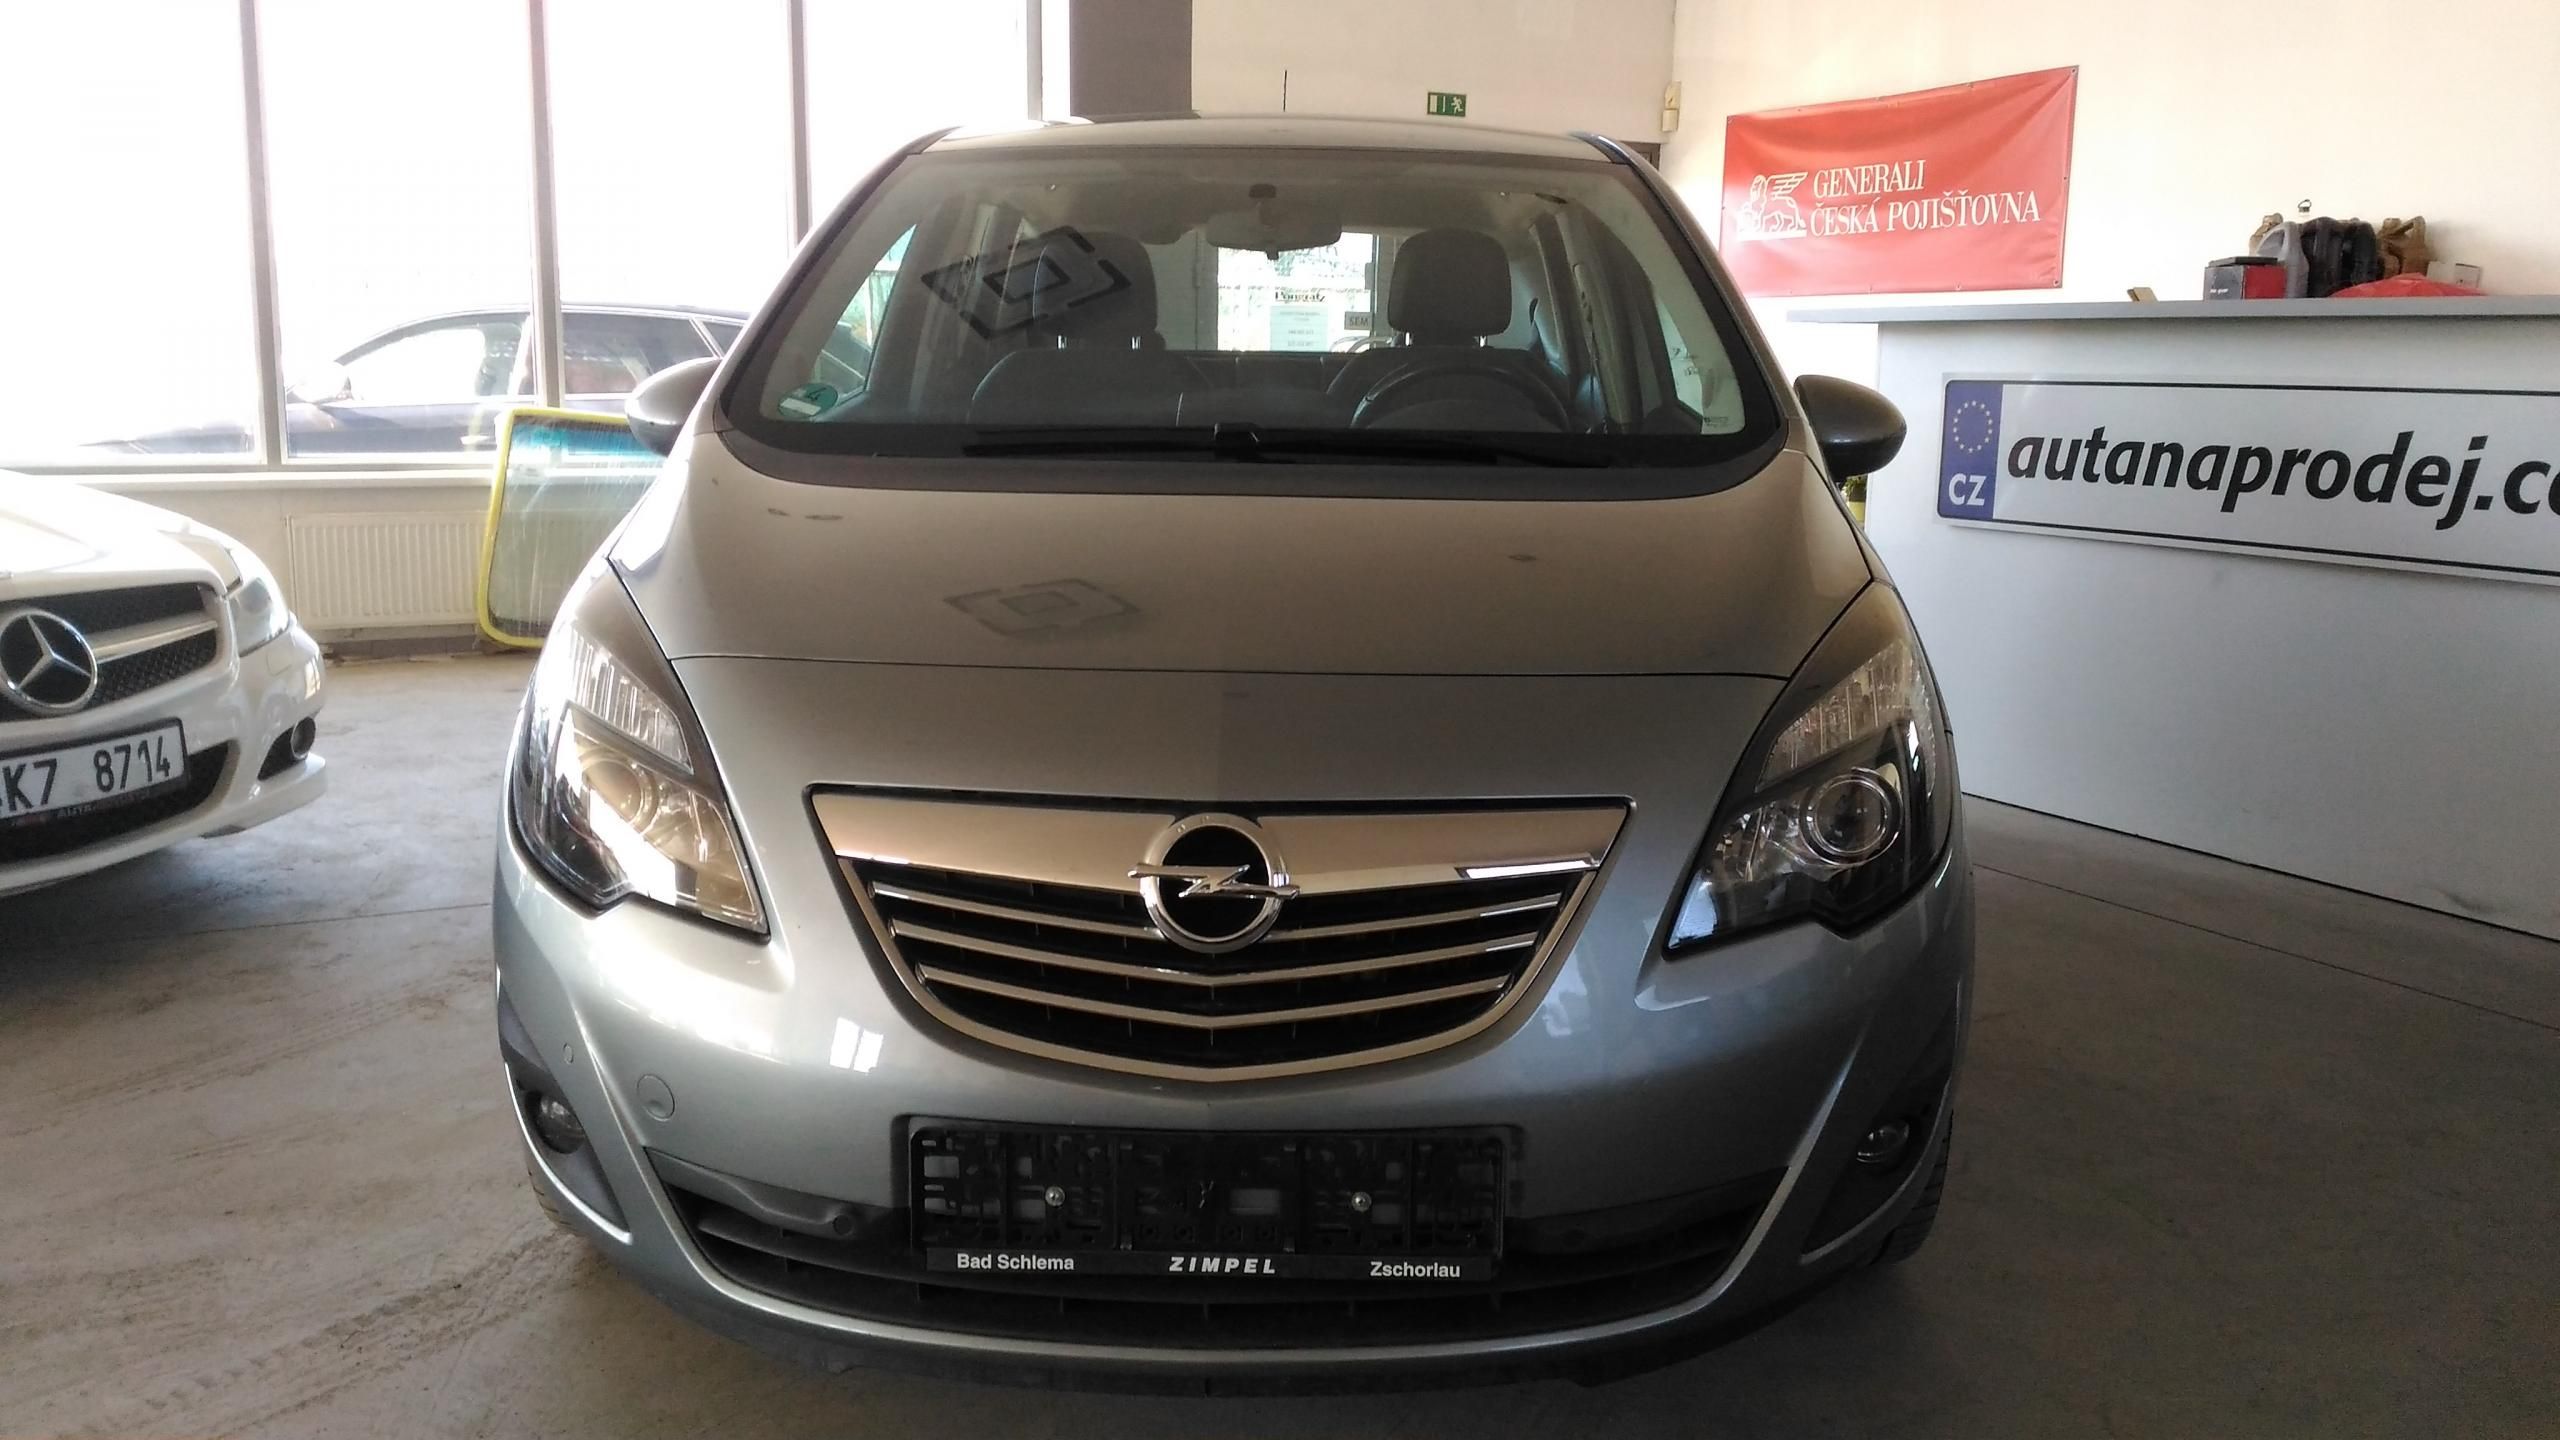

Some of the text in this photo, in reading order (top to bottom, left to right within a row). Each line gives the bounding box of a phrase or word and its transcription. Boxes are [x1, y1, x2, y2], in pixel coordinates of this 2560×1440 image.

[1813, 160, 1926, 199] GENERALI
[1810, 189, 2041, 238] ČESKÁ POJIŠŤOVNA
[1948, 426, 2560, 530] CZ autanaprodej.c
[0, 758, 58, 811] K7
[94, 736, 170, 792] 8714
[957, 1253, 1075, 1272] Bad Schlema
[1169, 1256, 1277, 1274] ZIMPEL
[1370, 1260, 1462, 1278] Zschorlau
